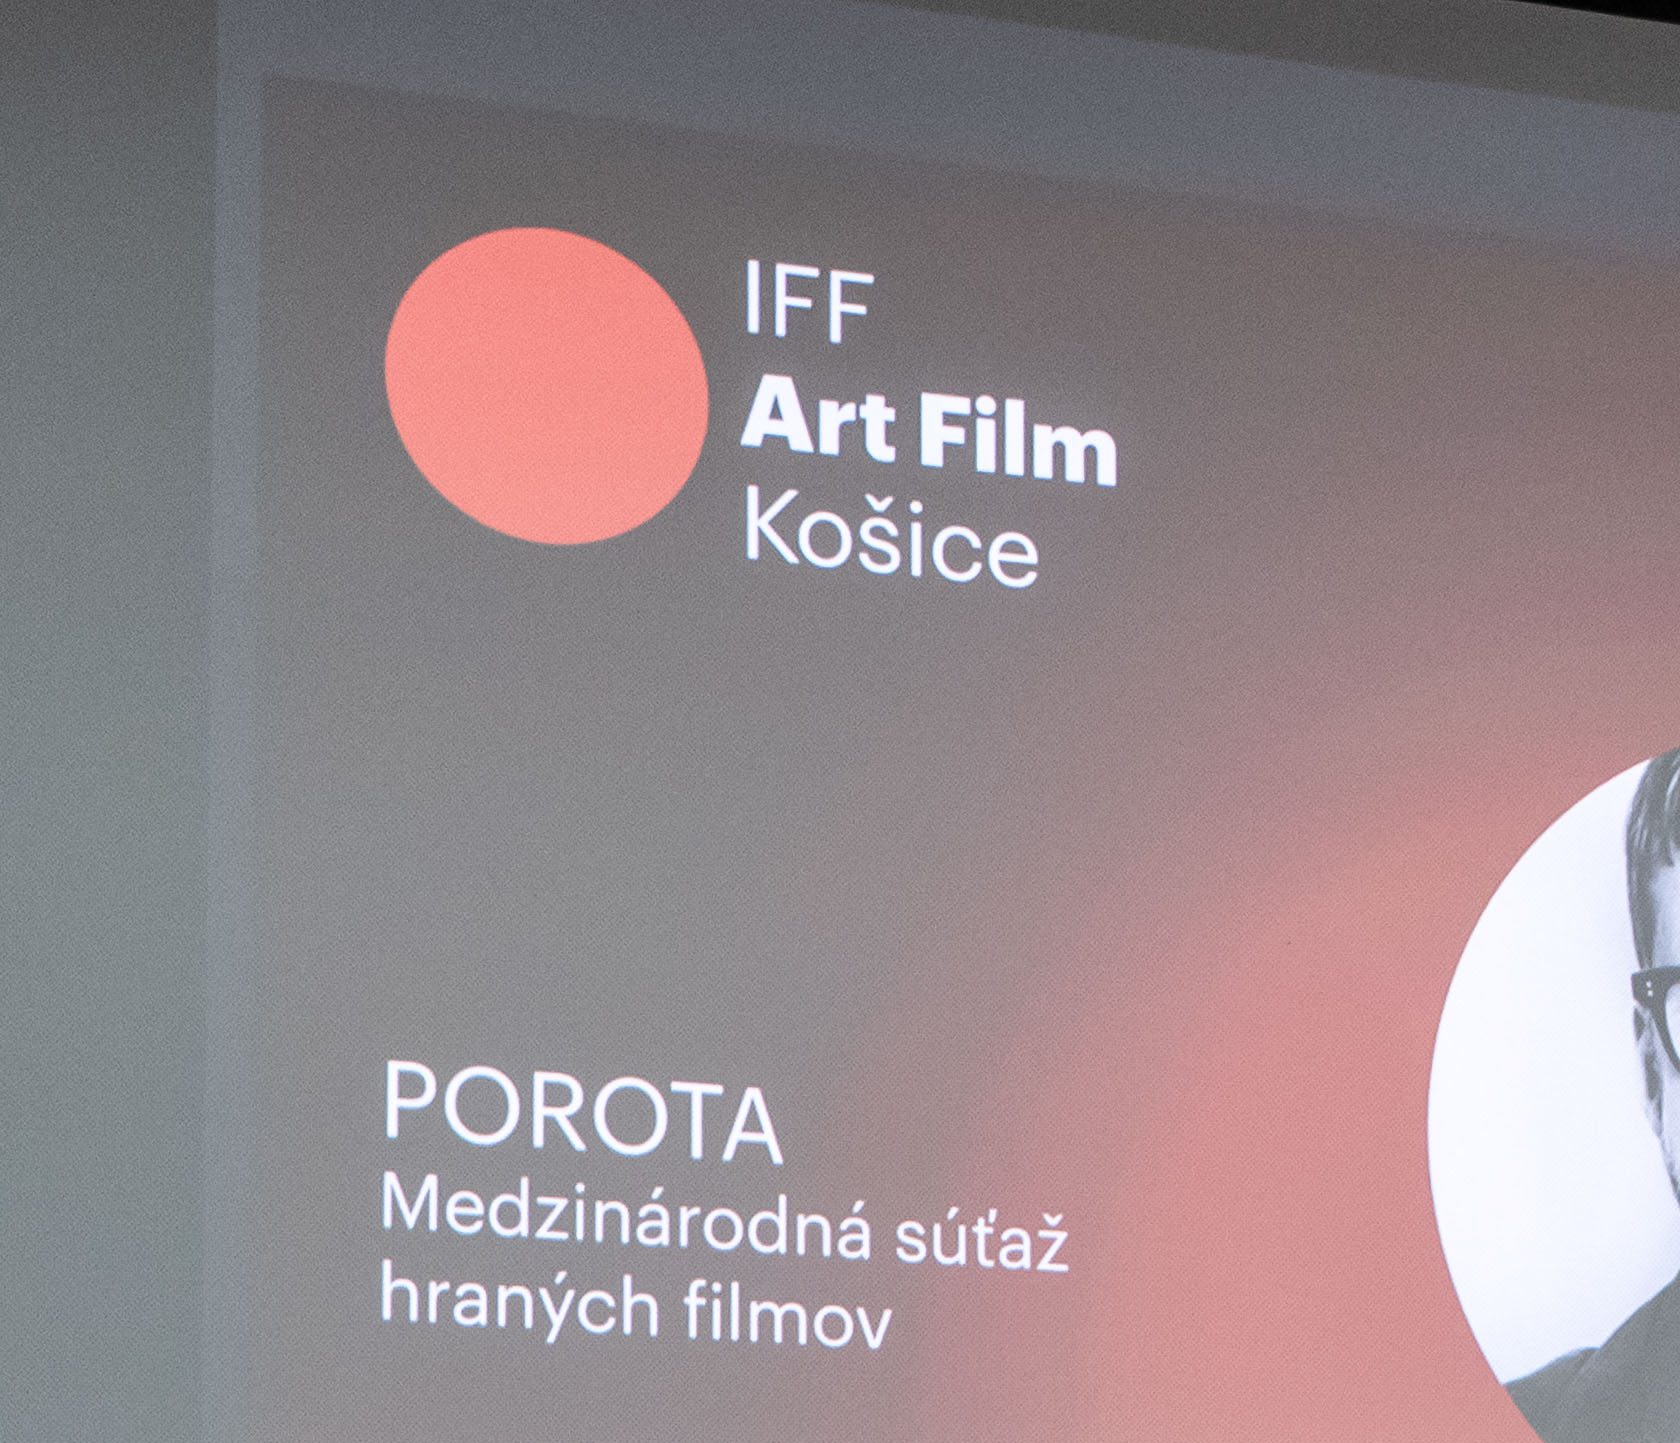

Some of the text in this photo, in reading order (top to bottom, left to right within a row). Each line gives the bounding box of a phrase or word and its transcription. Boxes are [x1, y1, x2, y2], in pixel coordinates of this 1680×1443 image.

[746, 259, 875, 344] IFF
[740, 373, 1118, 487] Art Film
[746, 485, 1040, 589] Košice
[386, 1060, 784, 1166] POROTA
[381, 1171, 1070, 1274] Medzinárodná súťaž
[381, 1259, 893, 1350] hraných filmov
